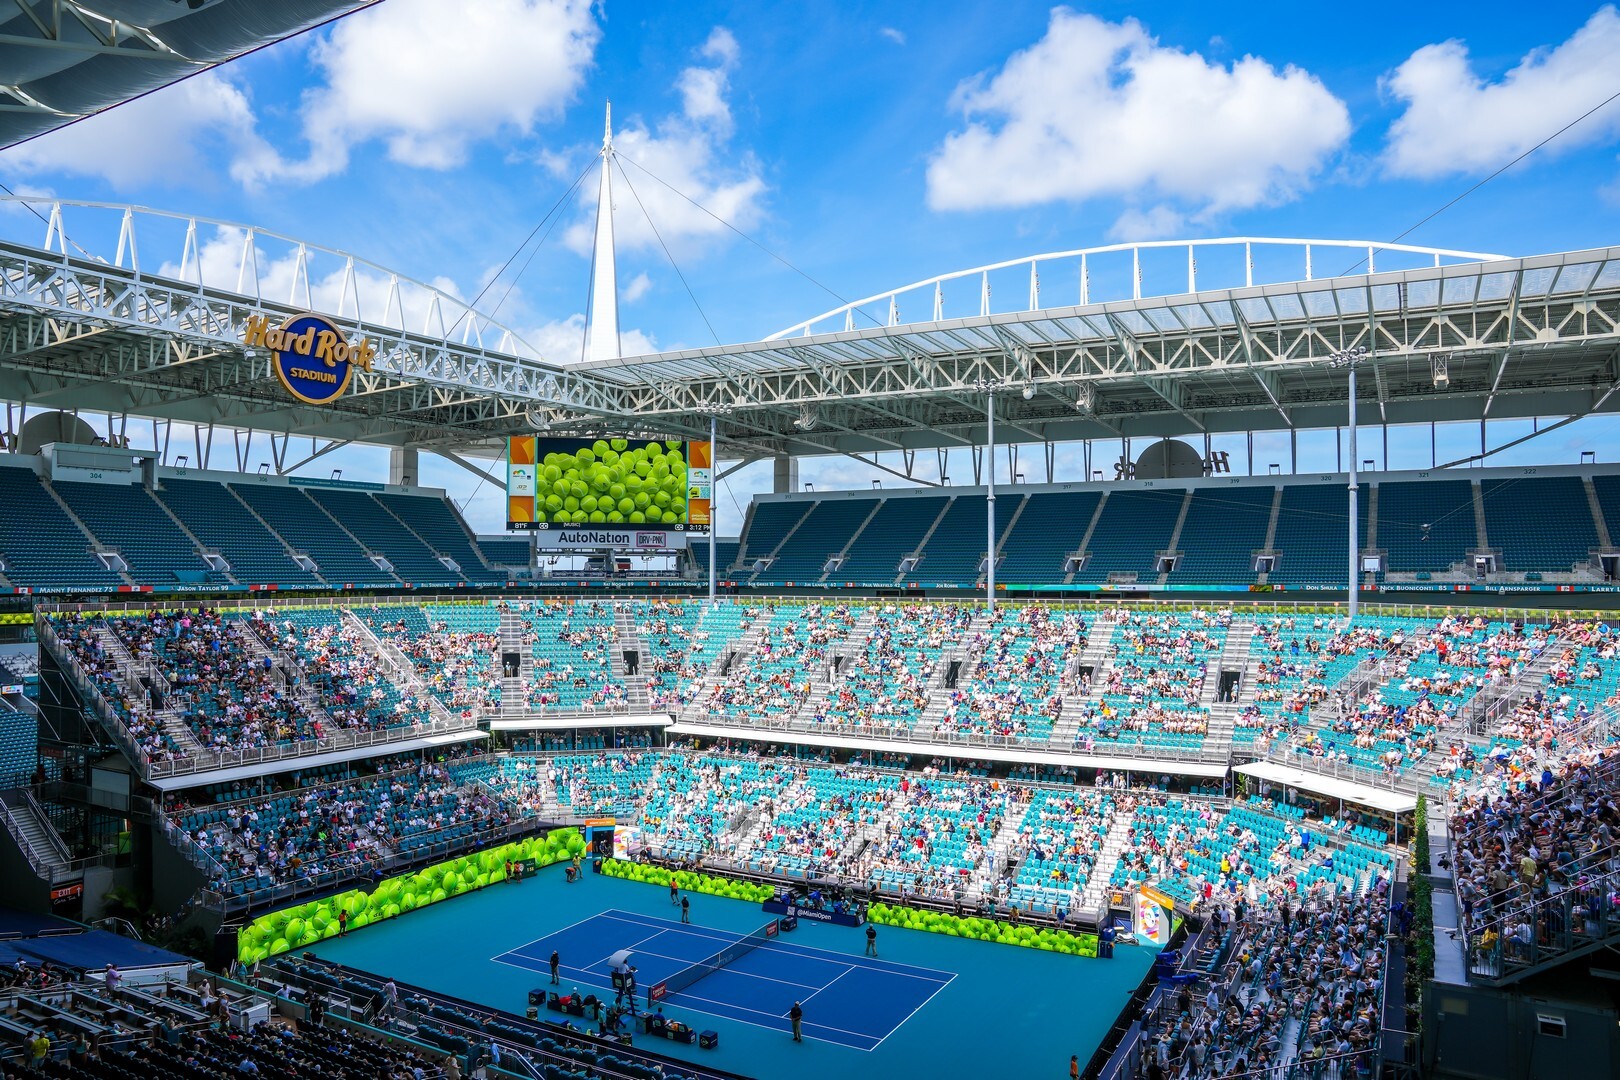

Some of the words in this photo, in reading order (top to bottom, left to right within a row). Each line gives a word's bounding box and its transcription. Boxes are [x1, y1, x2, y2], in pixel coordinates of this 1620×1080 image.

[244, 314, 317, 356] Hard
[314, 329, 375, 373] Rock
[290, 367, 337, 384] STADIUM
[558, 531, 630, 544] AutoNation
[58, 888, 71, 898] EXIT
[797, 909, 832, 920] @MiamiOpen
